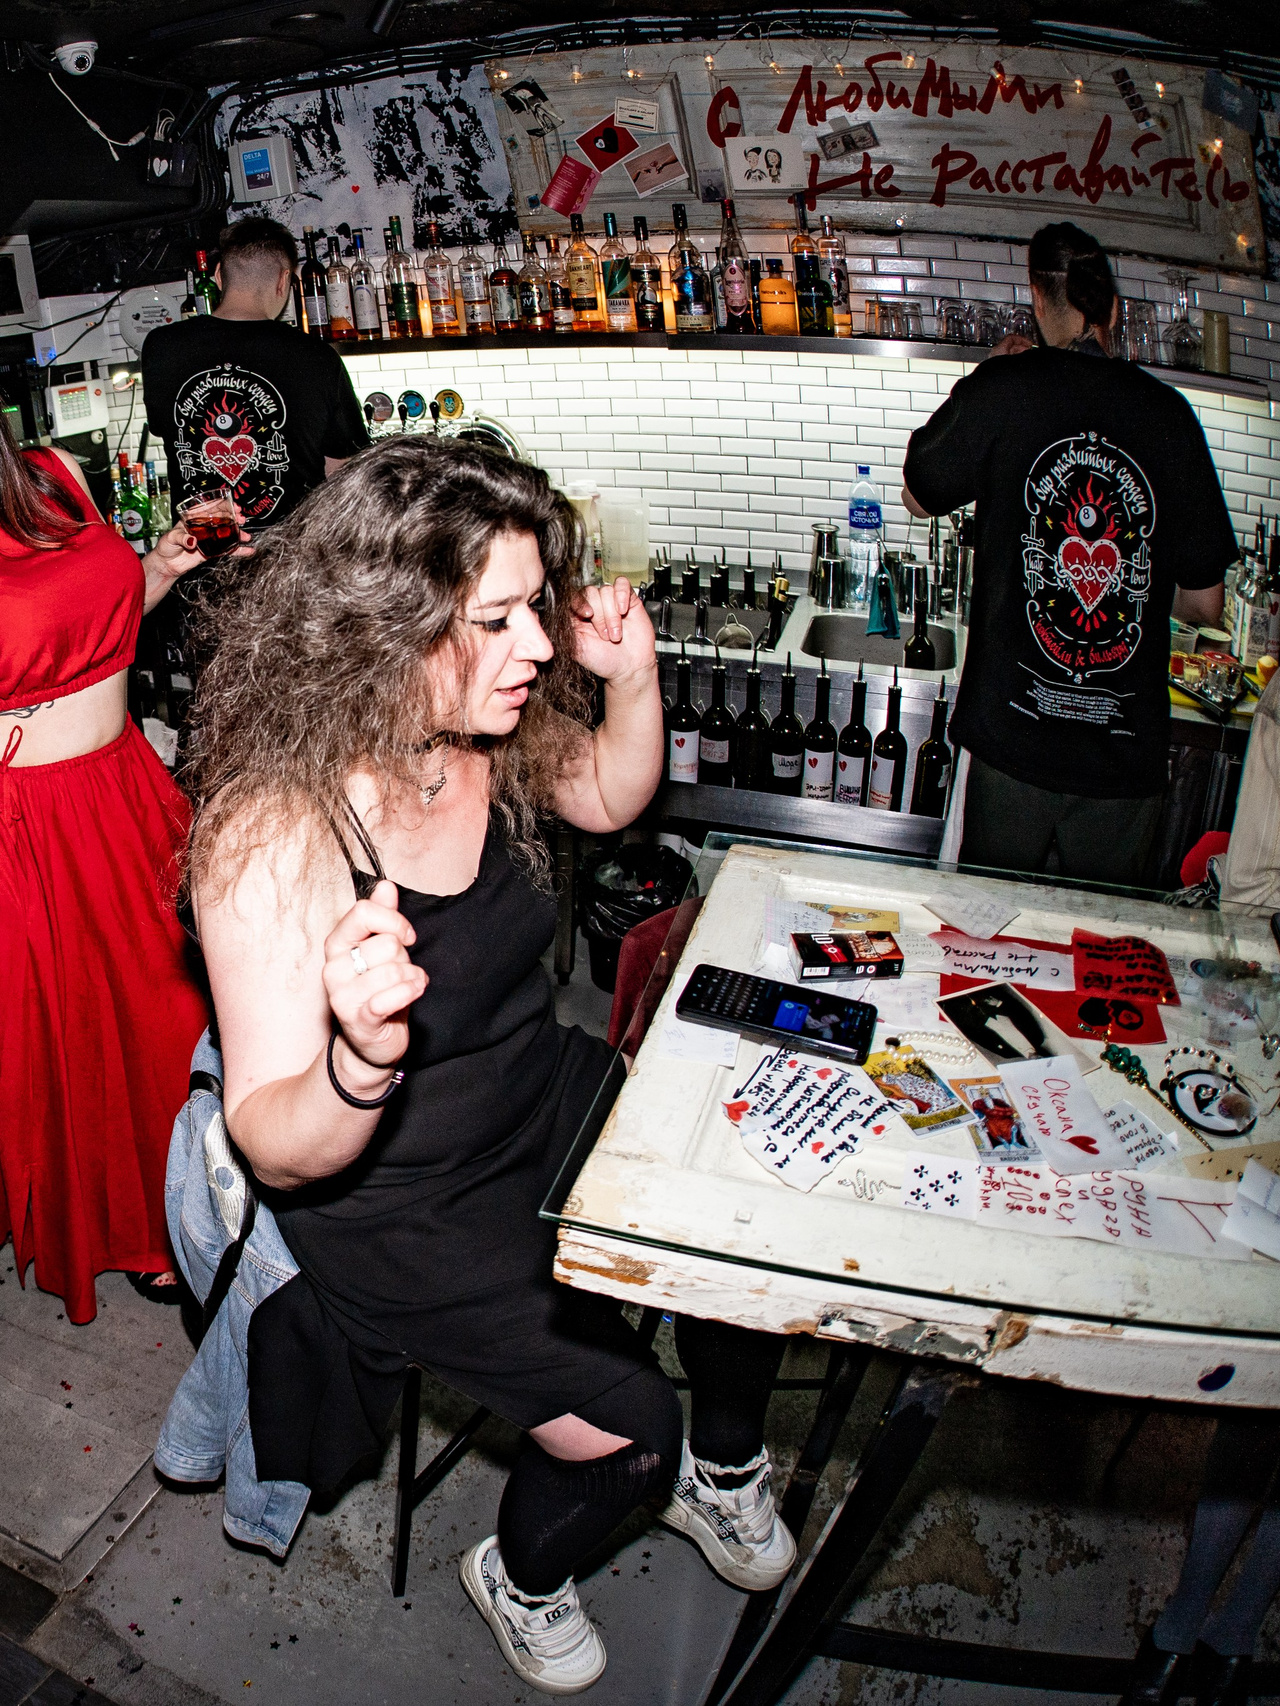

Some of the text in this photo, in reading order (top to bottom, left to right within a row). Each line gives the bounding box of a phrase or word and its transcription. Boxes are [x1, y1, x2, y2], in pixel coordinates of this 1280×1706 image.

[706, 86, 741, 148] С
[243, 152, 261, 160] DELTA
[787, 153, 902, 211] Не
[191, 371, 249, 403] разбитых
[247, 383, 278, 414] сердец
[220, 416, 226, 424] 8
[1029, 439, 1149, 516] бар разбитых сердец
[1082, 507, 1090, 520] 8
[1042, 1077, 1075, 1134] Оксана
[1118, 1173, 1153, 1239] РУНА
[544, 1603, 571, 1624] DG
